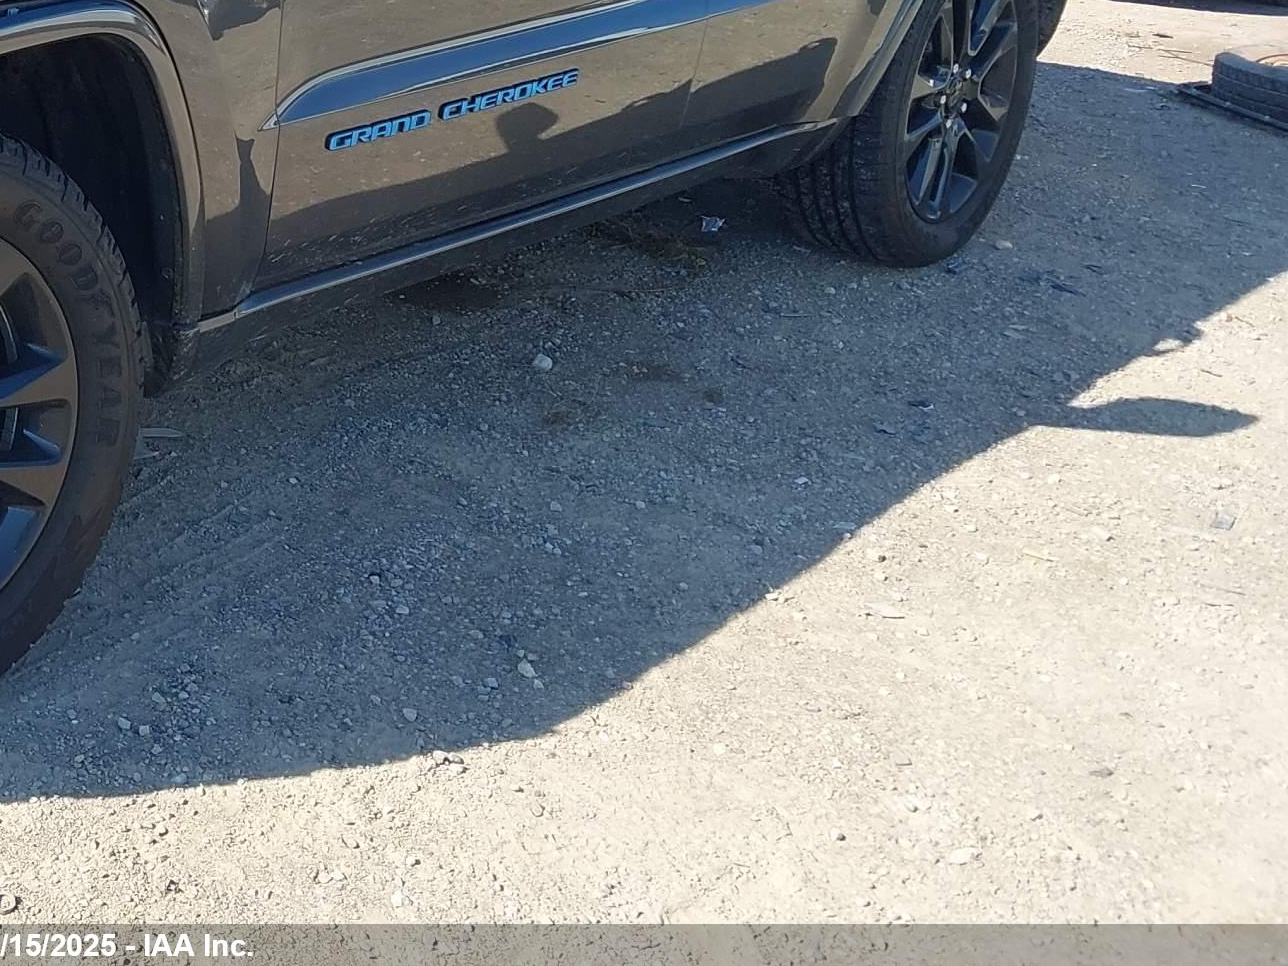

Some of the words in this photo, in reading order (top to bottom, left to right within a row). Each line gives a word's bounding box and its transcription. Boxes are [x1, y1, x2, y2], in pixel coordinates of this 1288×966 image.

[326, 109, 432, 151] GRAND
[438, 68, 580, 121] CHEROKEE
[14, 200, 122, 446] GOODYEAR
